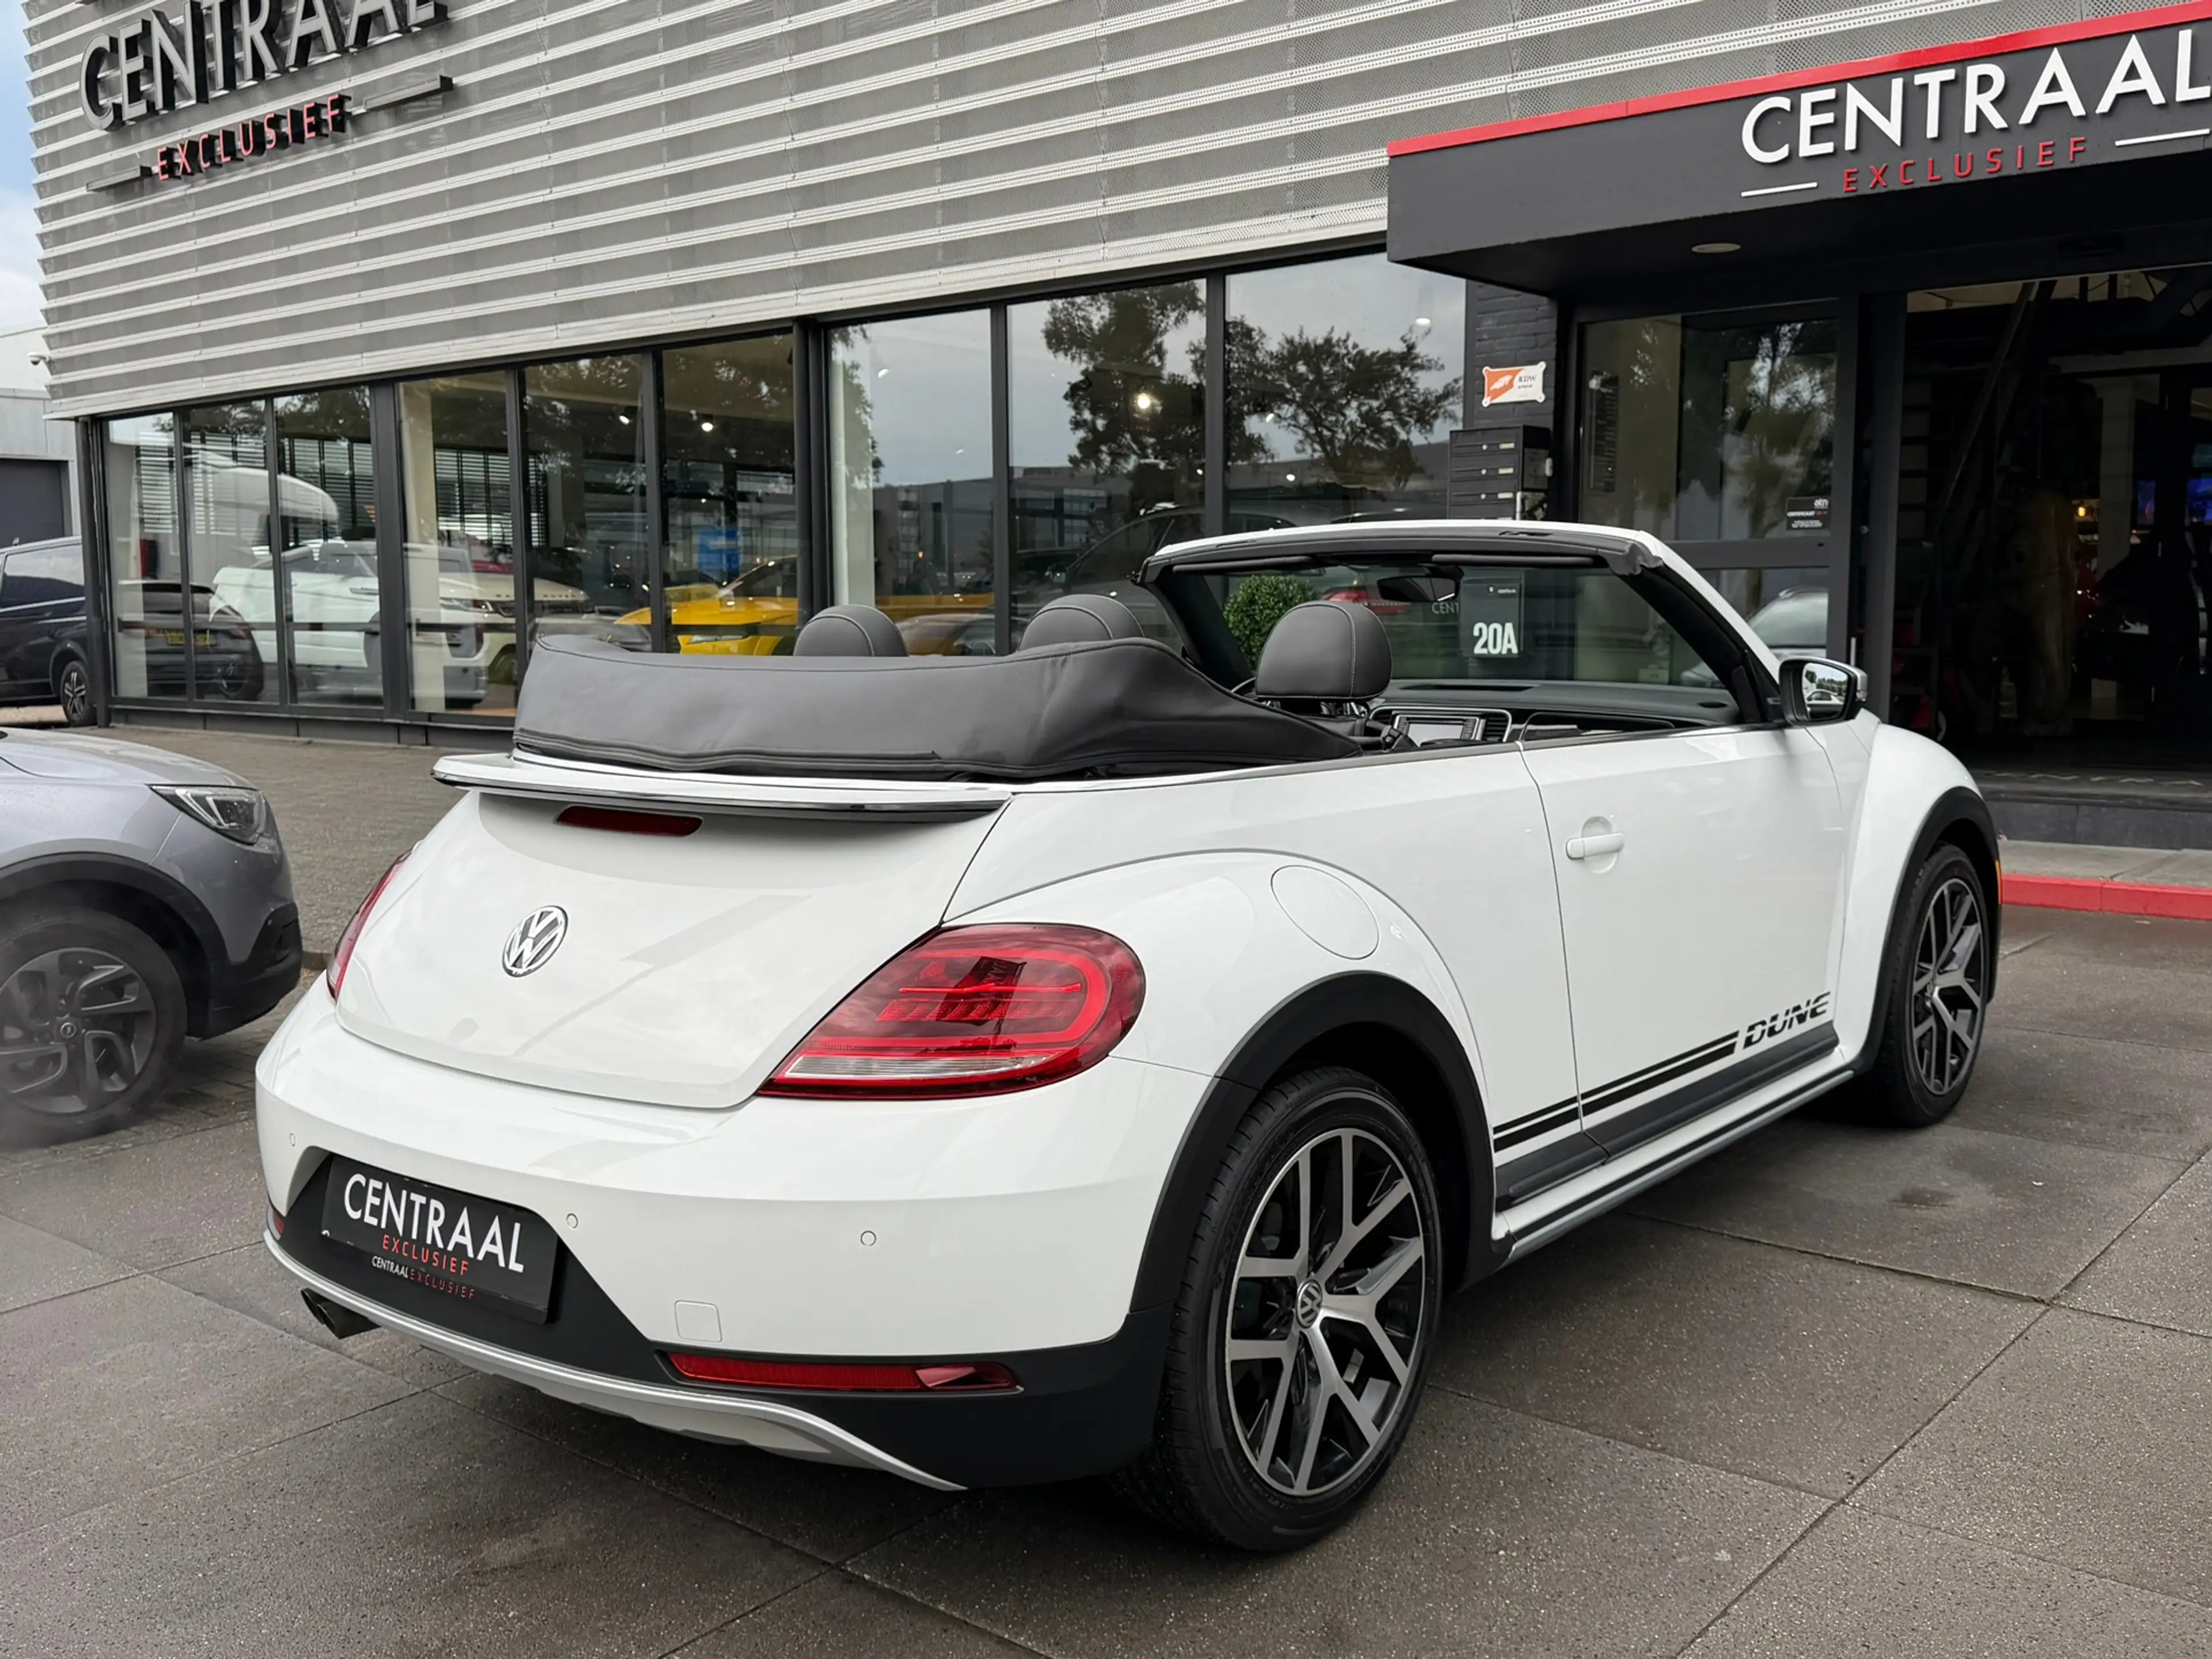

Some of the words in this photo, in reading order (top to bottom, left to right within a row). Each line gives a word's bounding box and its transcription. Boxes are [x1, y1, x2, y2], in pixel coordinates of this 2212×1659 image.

[79, 0, 437, 131] CENTRA
[1741, 28, 2211, 164] CENTRAAL
[157, 93, 341, 181] EXCLUSIEF
[1843, 136, 2088, 193] EXCLUSIEF
[1472, 622, 1518, 655] 20A
[1742, 991, 1831, 1050] DUNE
[344, 1173, 524, 1274] CENTRAAL
[382, 1234, 469, 1276] EXCLUSIEF
